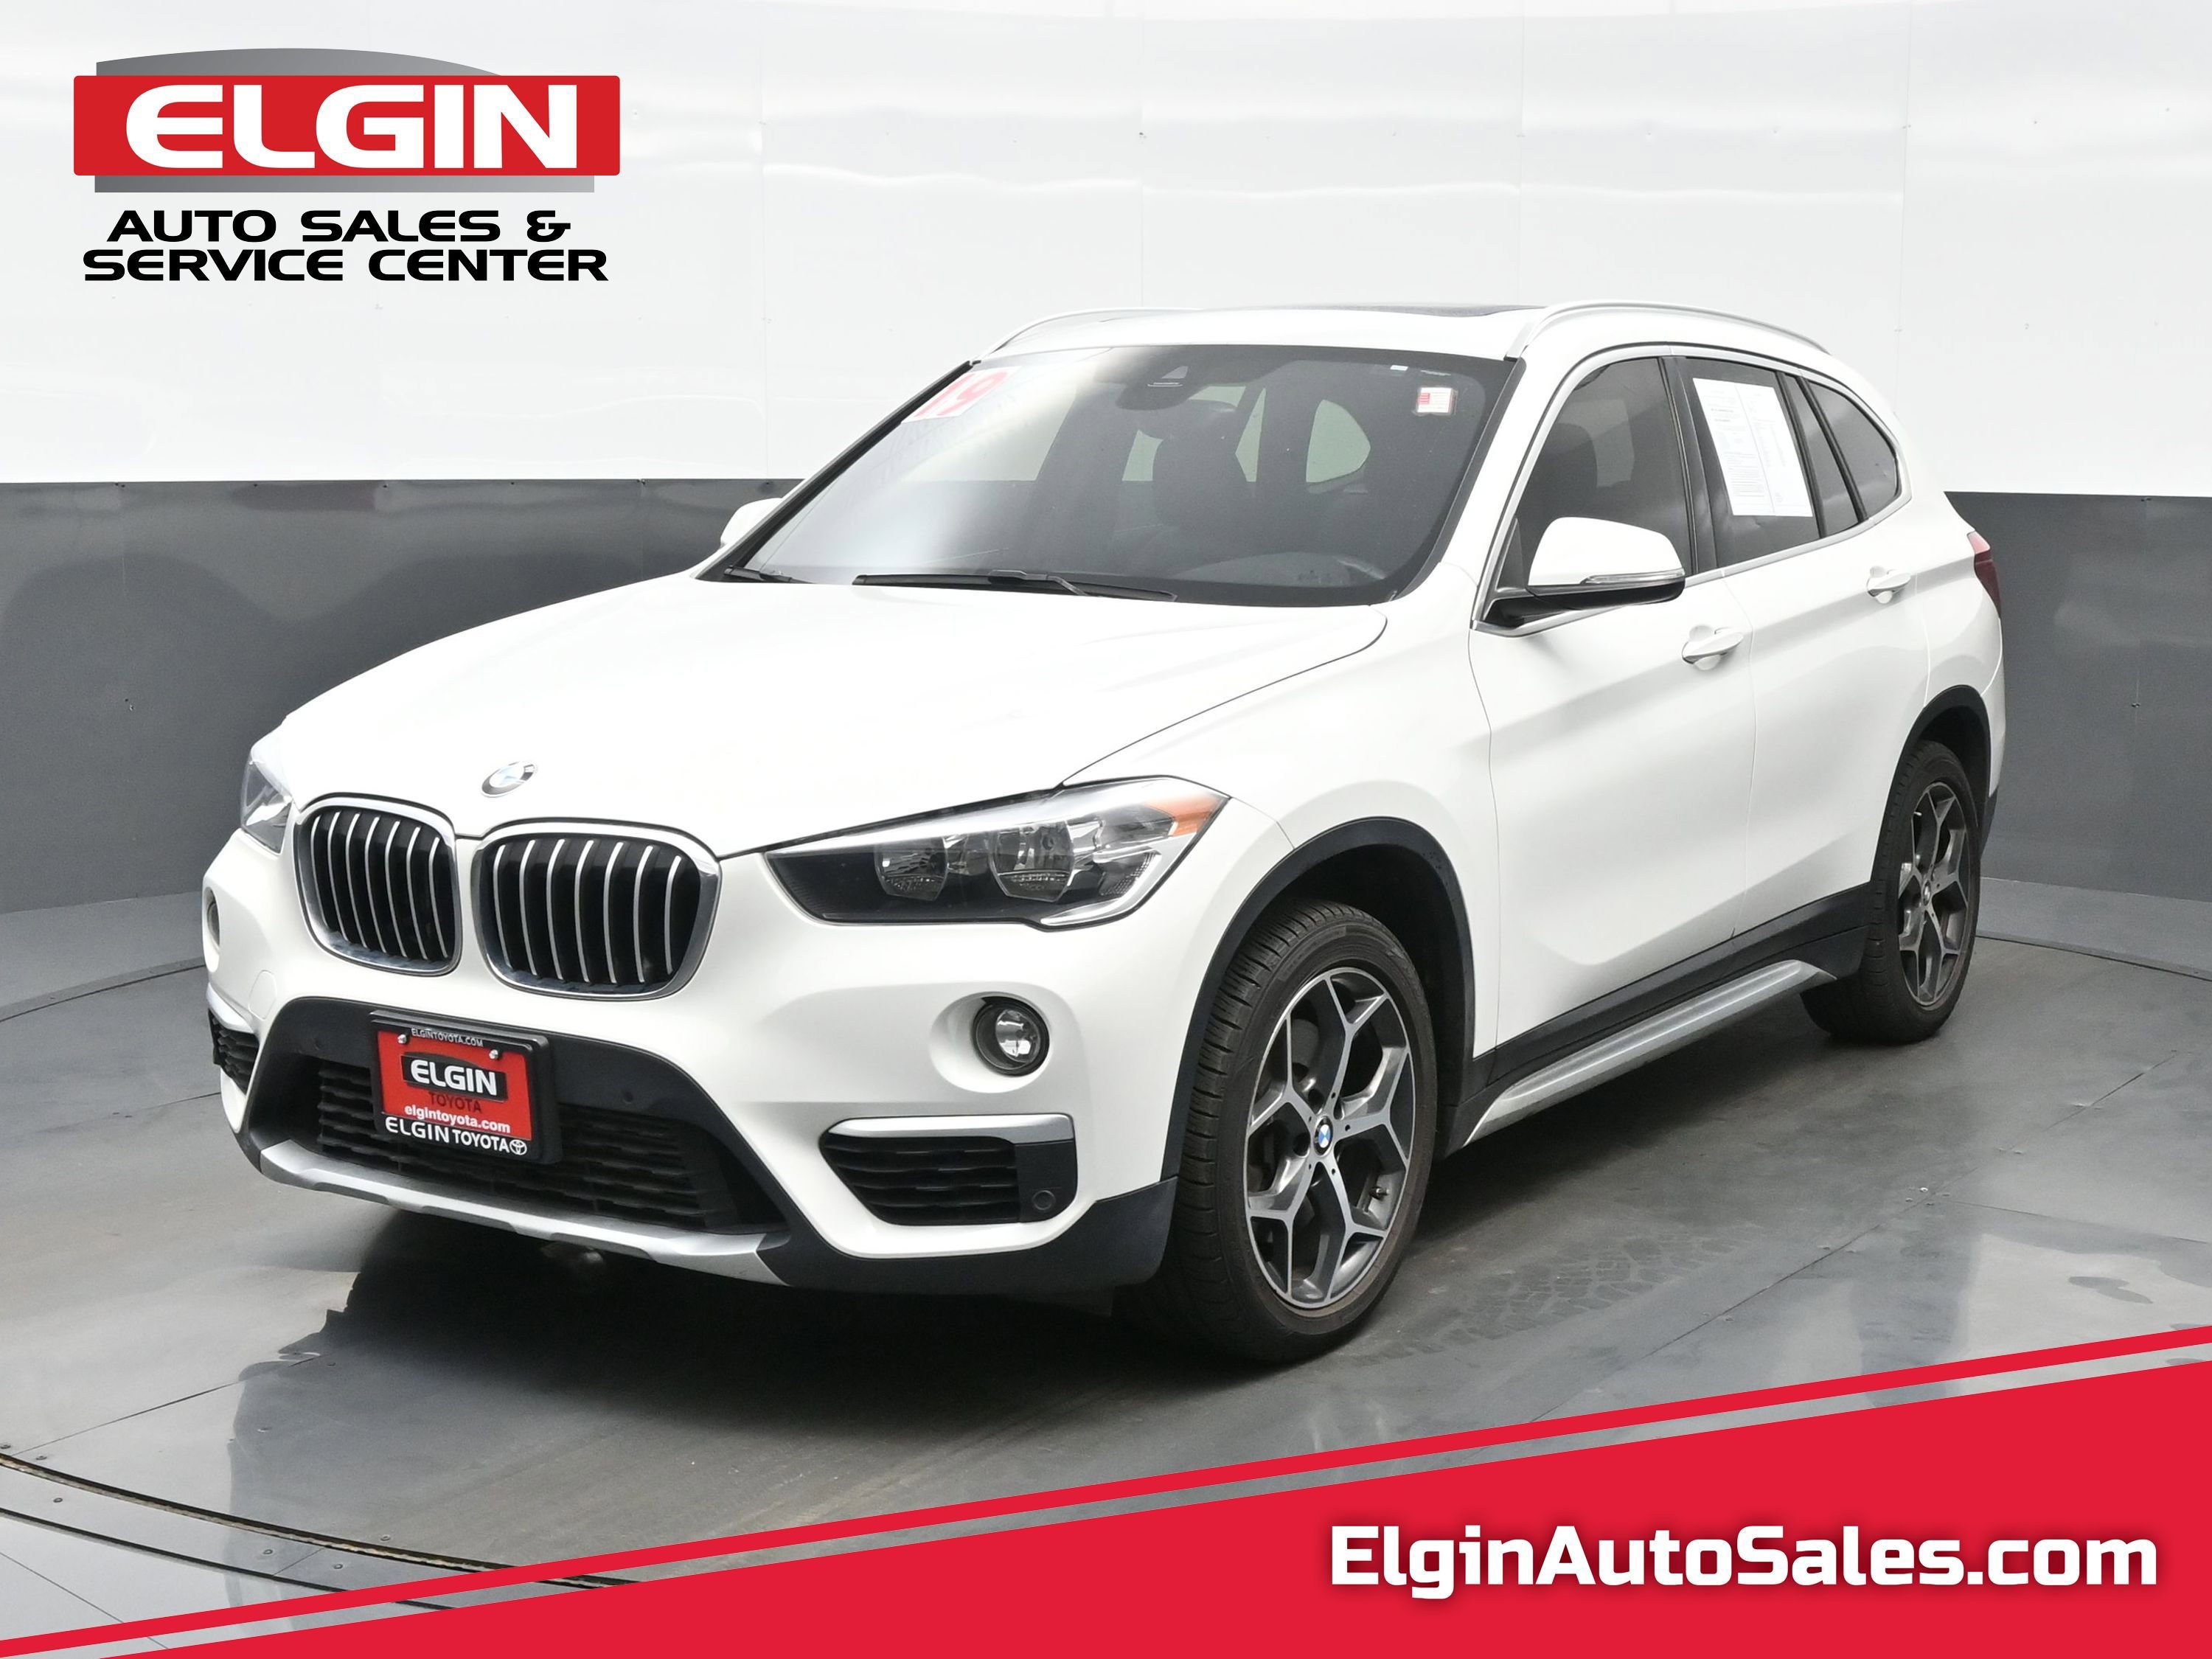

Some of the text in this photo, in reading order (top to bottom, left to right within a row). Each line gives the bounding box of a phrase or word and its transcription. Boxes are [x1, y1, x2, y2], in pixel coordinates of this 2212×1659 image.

[914, 372, 1007, 417] 19
[411, 1028, 484, 1048] ELGINTOYOTA.COM
[410, 1060, 498, 1096] ELGIN
[428, 1091, 482, 1113] TOYOTA
[385, 1116, 510, 1153] ELGIN TOYOTA
[404, 1105, 511, 1133] elgintoyota.com
